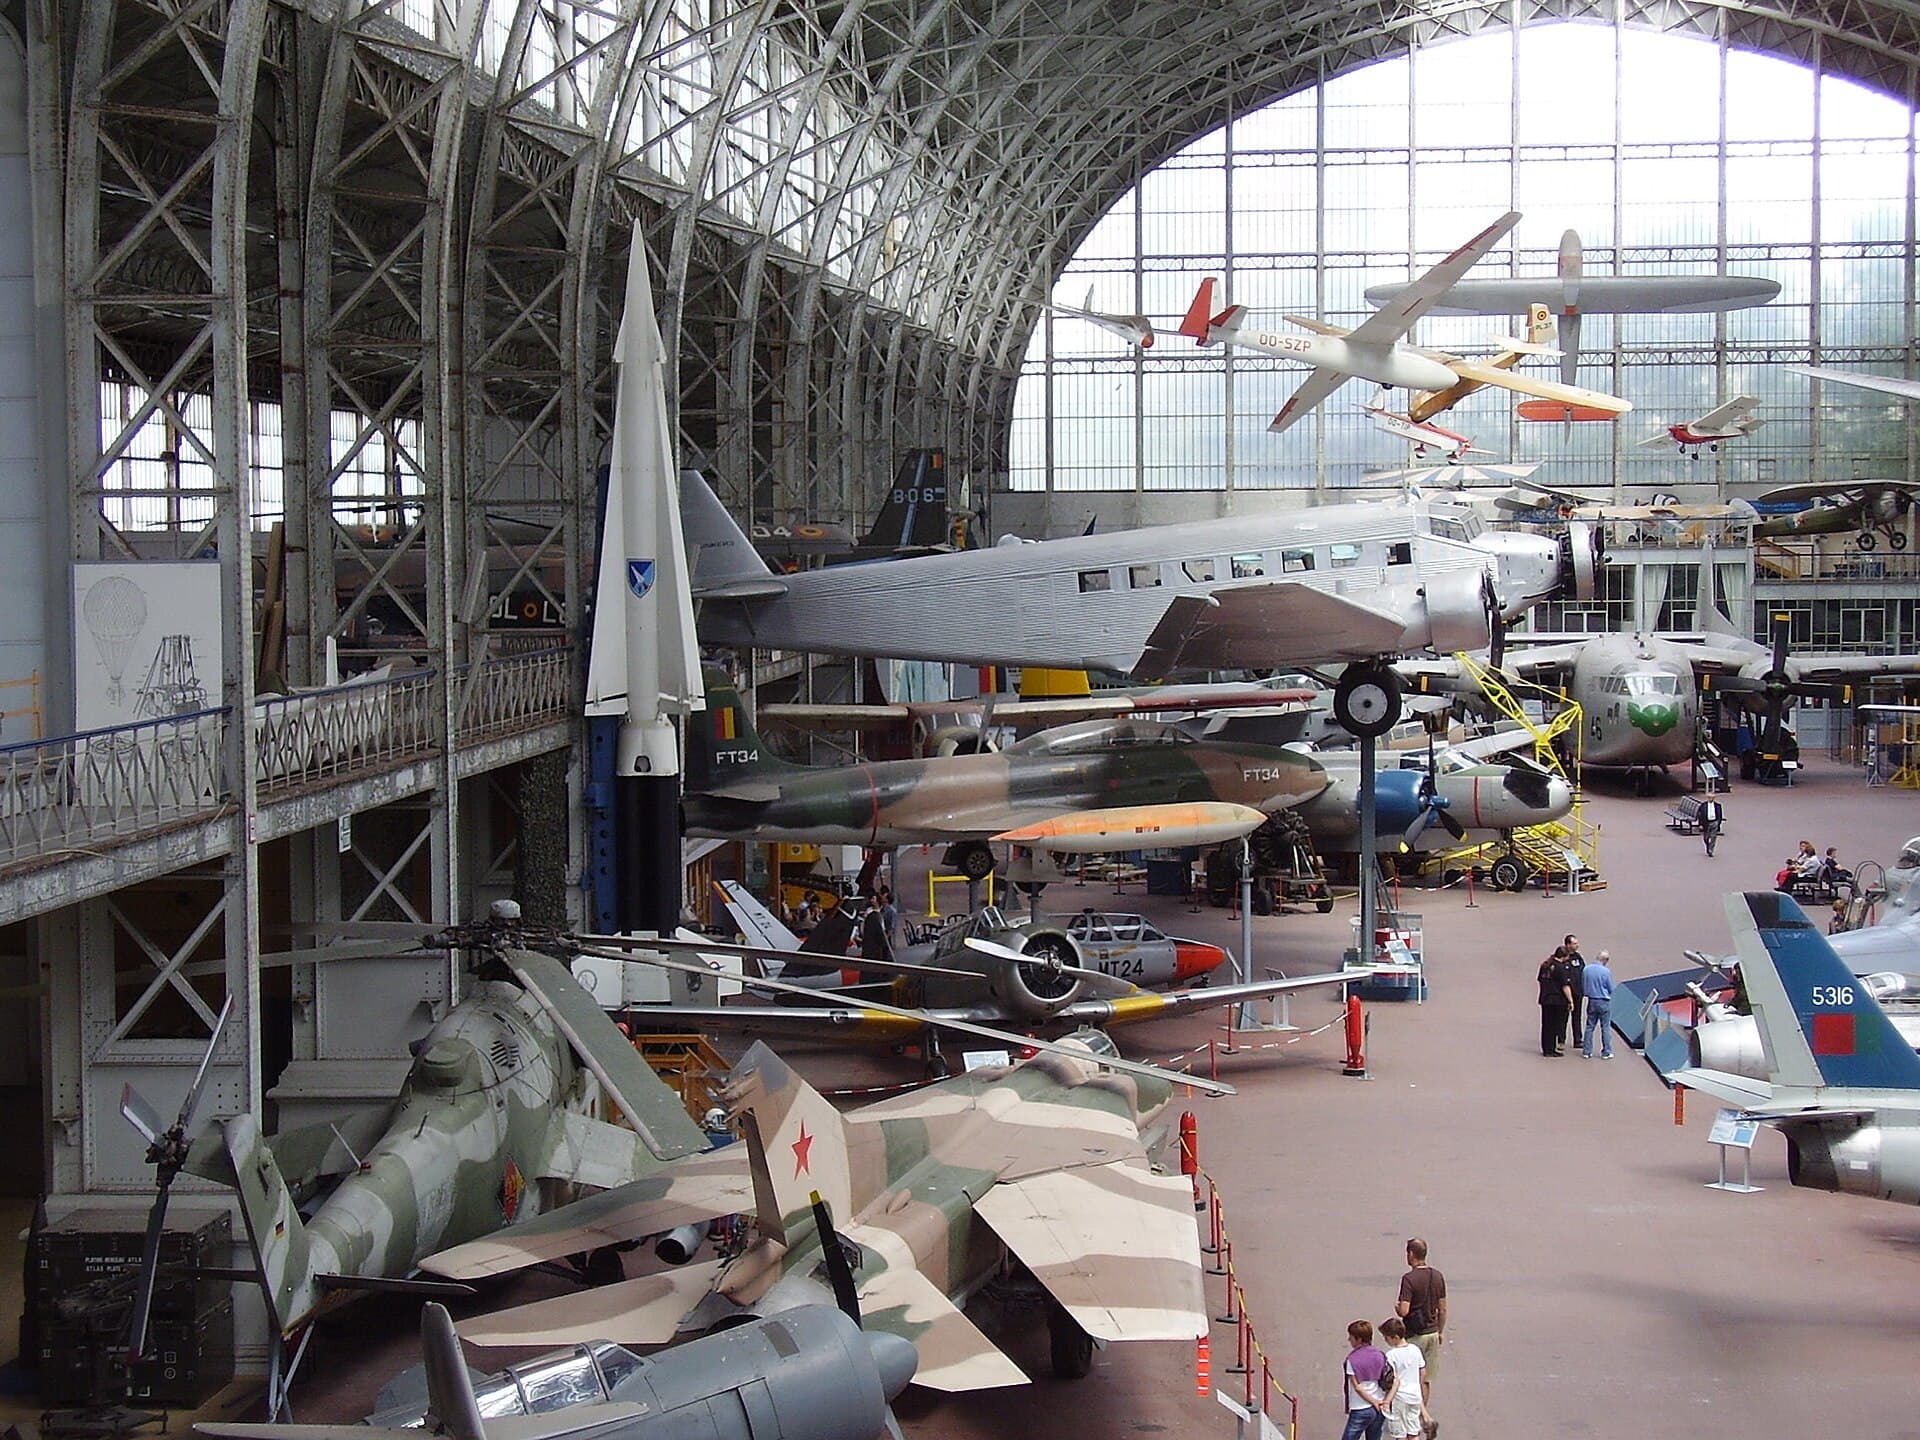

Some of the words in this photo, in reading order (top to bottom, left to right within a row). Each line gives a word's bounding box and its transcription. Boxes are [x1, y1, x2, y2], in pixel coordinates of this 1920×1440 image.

[1260, 334, 1311, 352] OO-SZP
[716, 750, 758, 764] FT34
[1243, 768, 1280, 782] FT34
[1099, 958, 1144, 977] MT24
[1812, 986, 1854, 1006] 5316
